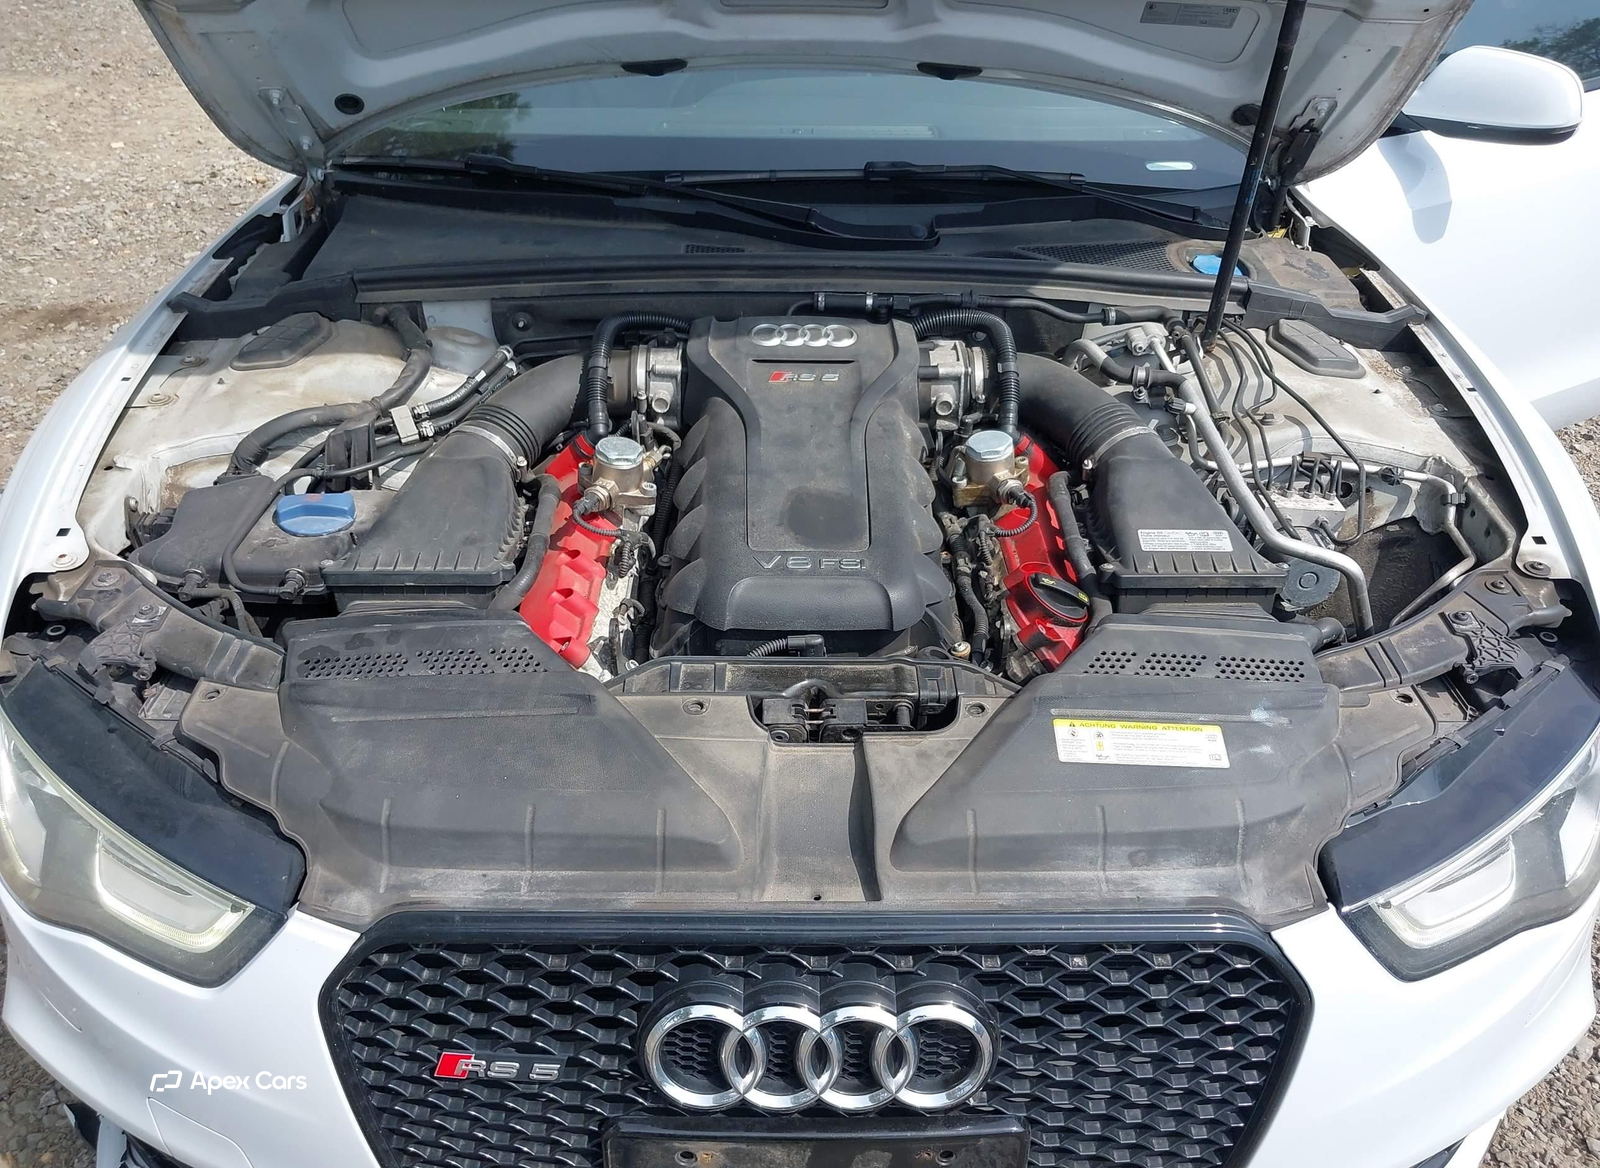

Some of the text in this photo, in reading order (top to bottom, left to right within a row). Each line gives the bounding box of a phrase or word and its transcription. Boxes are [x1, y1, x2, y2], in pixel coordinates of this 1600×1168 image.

[752, 555, 812, 570] V8
[454, 1059, 560, 1081] RS 5
